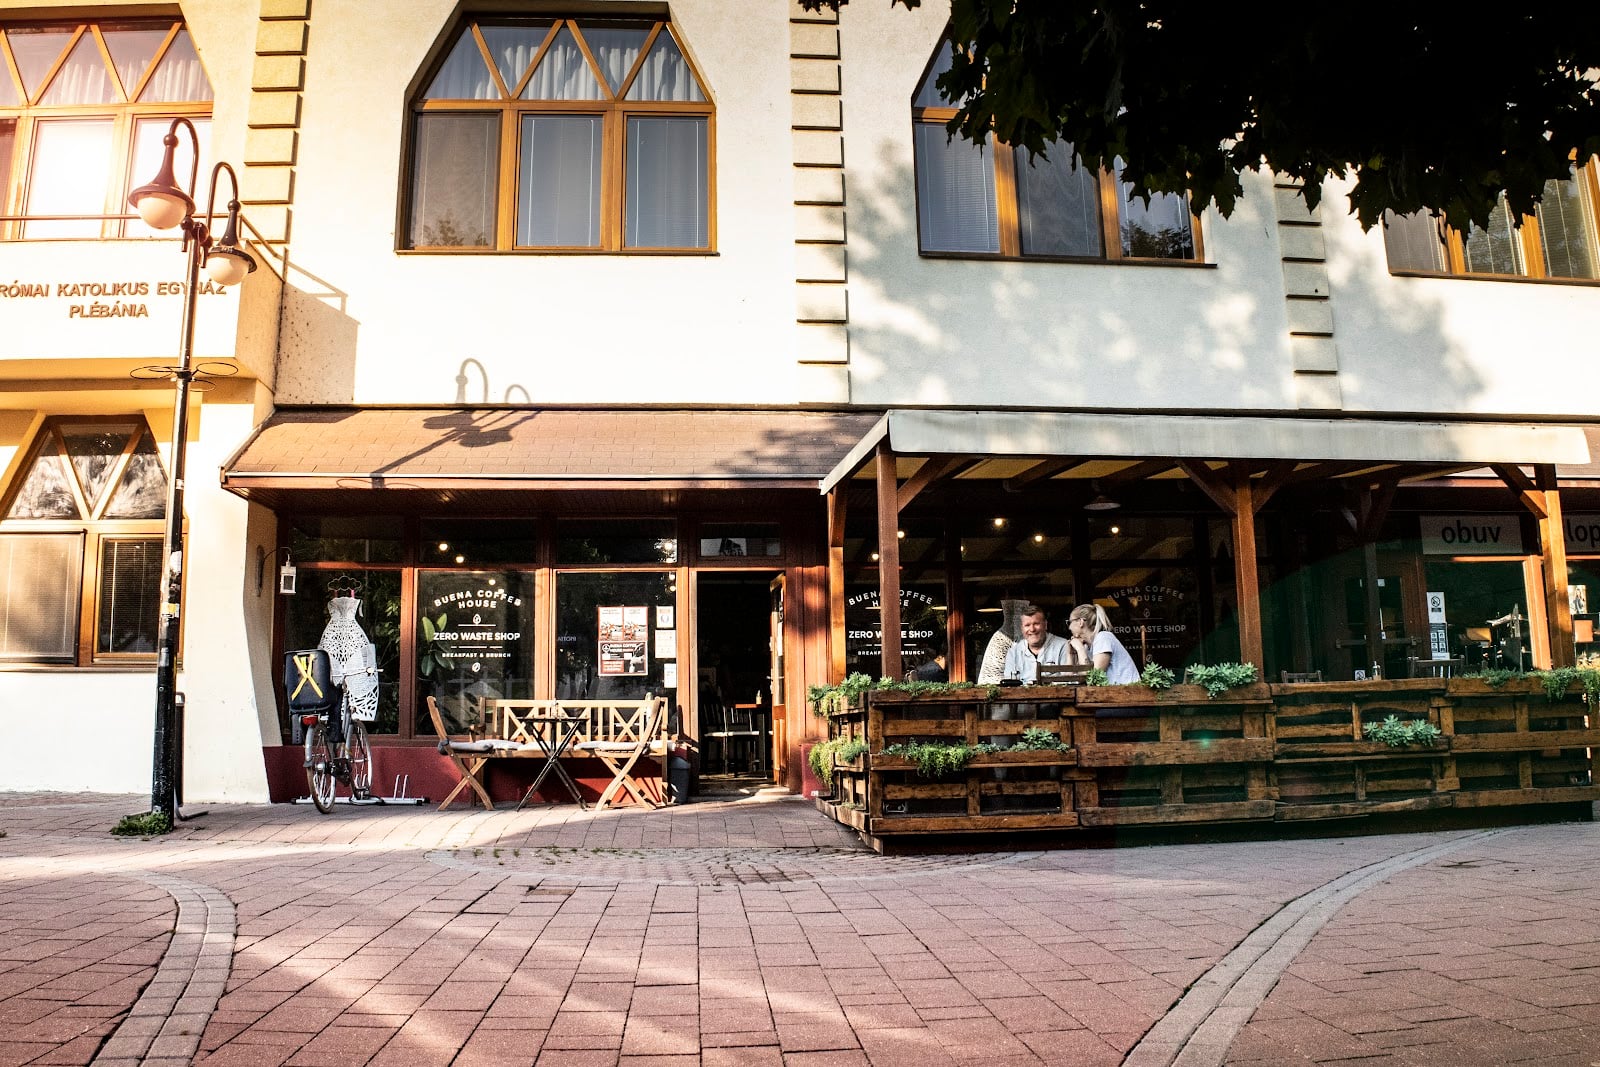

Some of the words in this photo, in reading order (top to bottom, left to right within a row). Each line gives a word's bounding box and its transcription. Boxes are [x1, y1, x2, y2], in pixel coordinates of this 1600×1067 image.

[0, 280, 49, 298] RÓMAI
[57, 282, 149, 297] KATOLIKUS
[69, 300, 149, 319] PLÉBÁNIA
[1441, 519, 1501, 544] obuv
[434, 590, 472, 607] BUENA
[848, 590, 881, 606] BUEN
[899, 589, 933, 605] OFFEE
[1145, 585, 1185, 600] COFFEE
[458, 600, 497, 609] HOUSE
[433, 632, 459, 641] ZERO
[460, 632, 493, 641] WASTE
[494, 632, 521, 641] SHOP
[848, 630, 874, 639] ZERO
[908, 630, 934, 639] SHOP
[1114, 625, 1131, 634] ERO
[1163, 624, 1187, 633] SHOP
